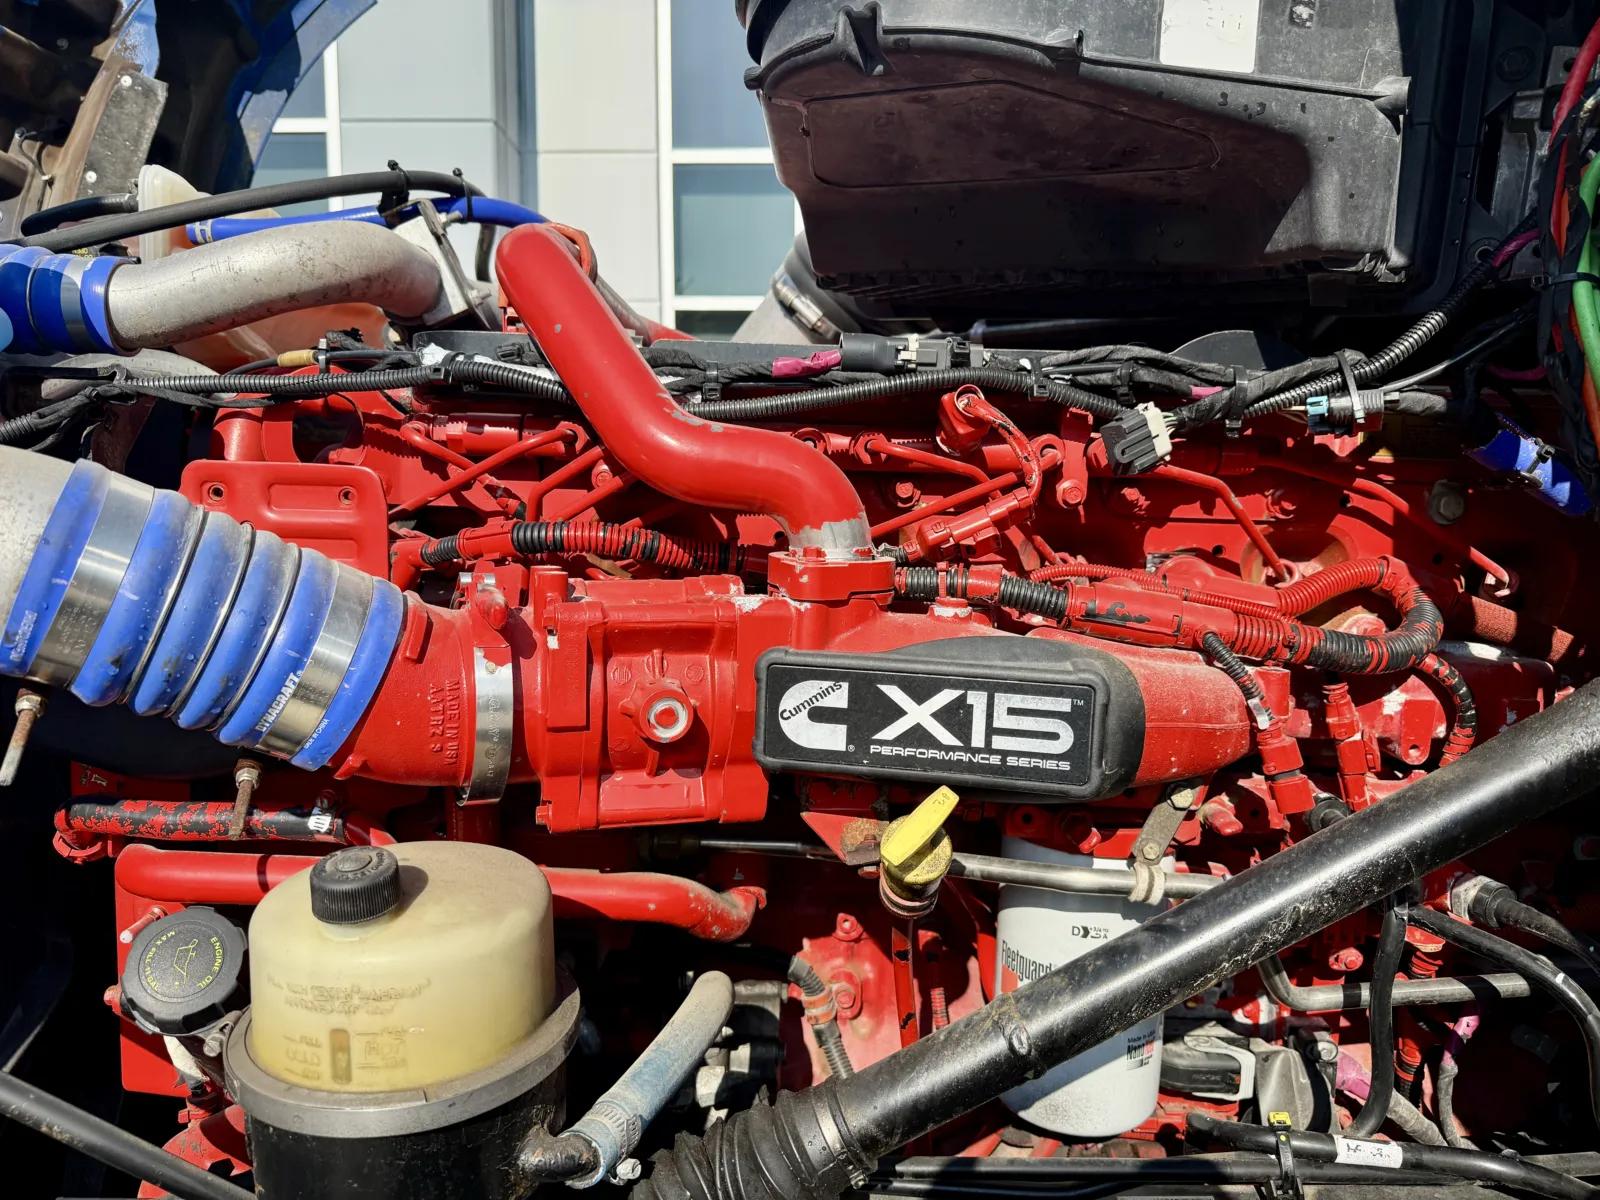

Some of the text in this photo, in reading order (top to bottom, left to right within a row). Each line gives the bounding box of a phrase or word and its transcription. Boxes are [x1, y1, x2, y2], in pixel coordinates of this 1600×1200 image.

[255, 672, 300, 732] DYNACRAFT
[444, 680, 460, 720] MADE
[779, 681, 843, 721] Cummins
[872, 684, 1074, 754] X15
[446, 723, 459, 739] IN
[870, 744, 1071, 770] PERFORMANCE SERIES
[196, 936, 223, 989] ENGINE OIL
